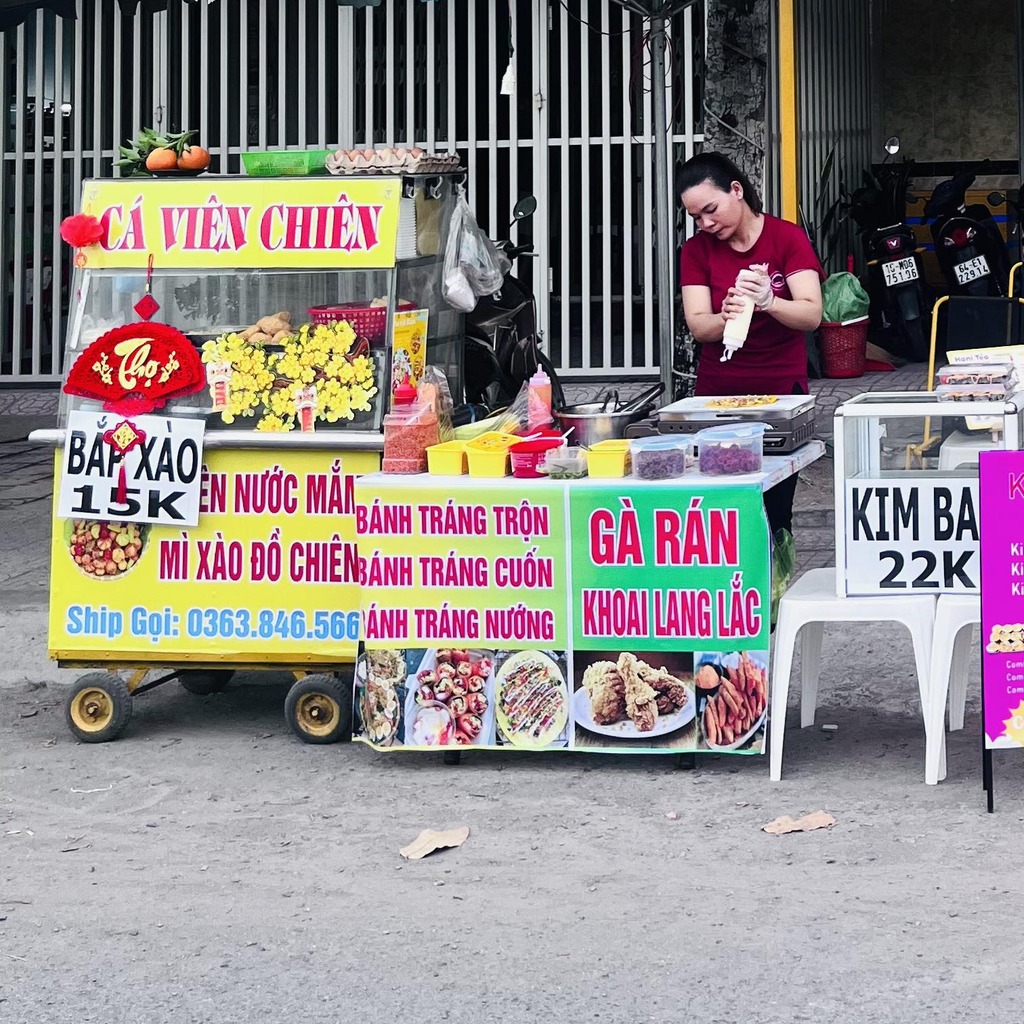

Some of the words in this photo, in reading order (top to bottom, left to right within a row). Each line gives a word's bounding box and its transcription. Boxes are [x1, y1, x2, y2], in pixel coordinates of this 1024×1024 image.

[100, 195, 147, 252] CÁ
[161, 194, 251, 252] VIÊN
[260, 193, 383, 252] CHIÊN
[114, 337, 161, 390] Thọ
[133, 420, 199, 484] XÀO
[71, 484, 187, 521] 15K
[199, 464, 227, 513] ÊN
[234, 465, 298, 514] NƯỚC
[852, 487, 919, 541] KIM
[933, 487, 979, 541] BA
[356, 499, 412, 534] BÁNH
[418, 499, 486, 535] TRÁNG
[494, 499, 549, 542] TRỘN
[589, 496, 643, 566] GÀ
[655, 496, 739, 566] RÁN
[160, 532, 188, 580] MÌ
[196, 532, 243, 581] XÀO
[251, 528, 282, 582] ĐỒ
[290, 534, 360, 583] CHIÊN
[359, 551, 412, 586] BÁNH
[419, 553, 487, 587] TRÁNG
[498, 547, 553, 588] CUỐN
[879, 550, 977, 588] 22K
[67, 606, 123, 638] Ship
[131, 607, 179, 642] Gọi:
[188, 608, 360, 641] 0363.846.566
[363, 603, 408, 638] ÁNH
[414, 604, 479, 639] TRÁNG
[485, 602, 555, 641] NƯỚNG
[582, 588, 648, 637] KHOAI
[654, 587, 711, 638] LANG
[717, 574, 761, 638] LẮC
